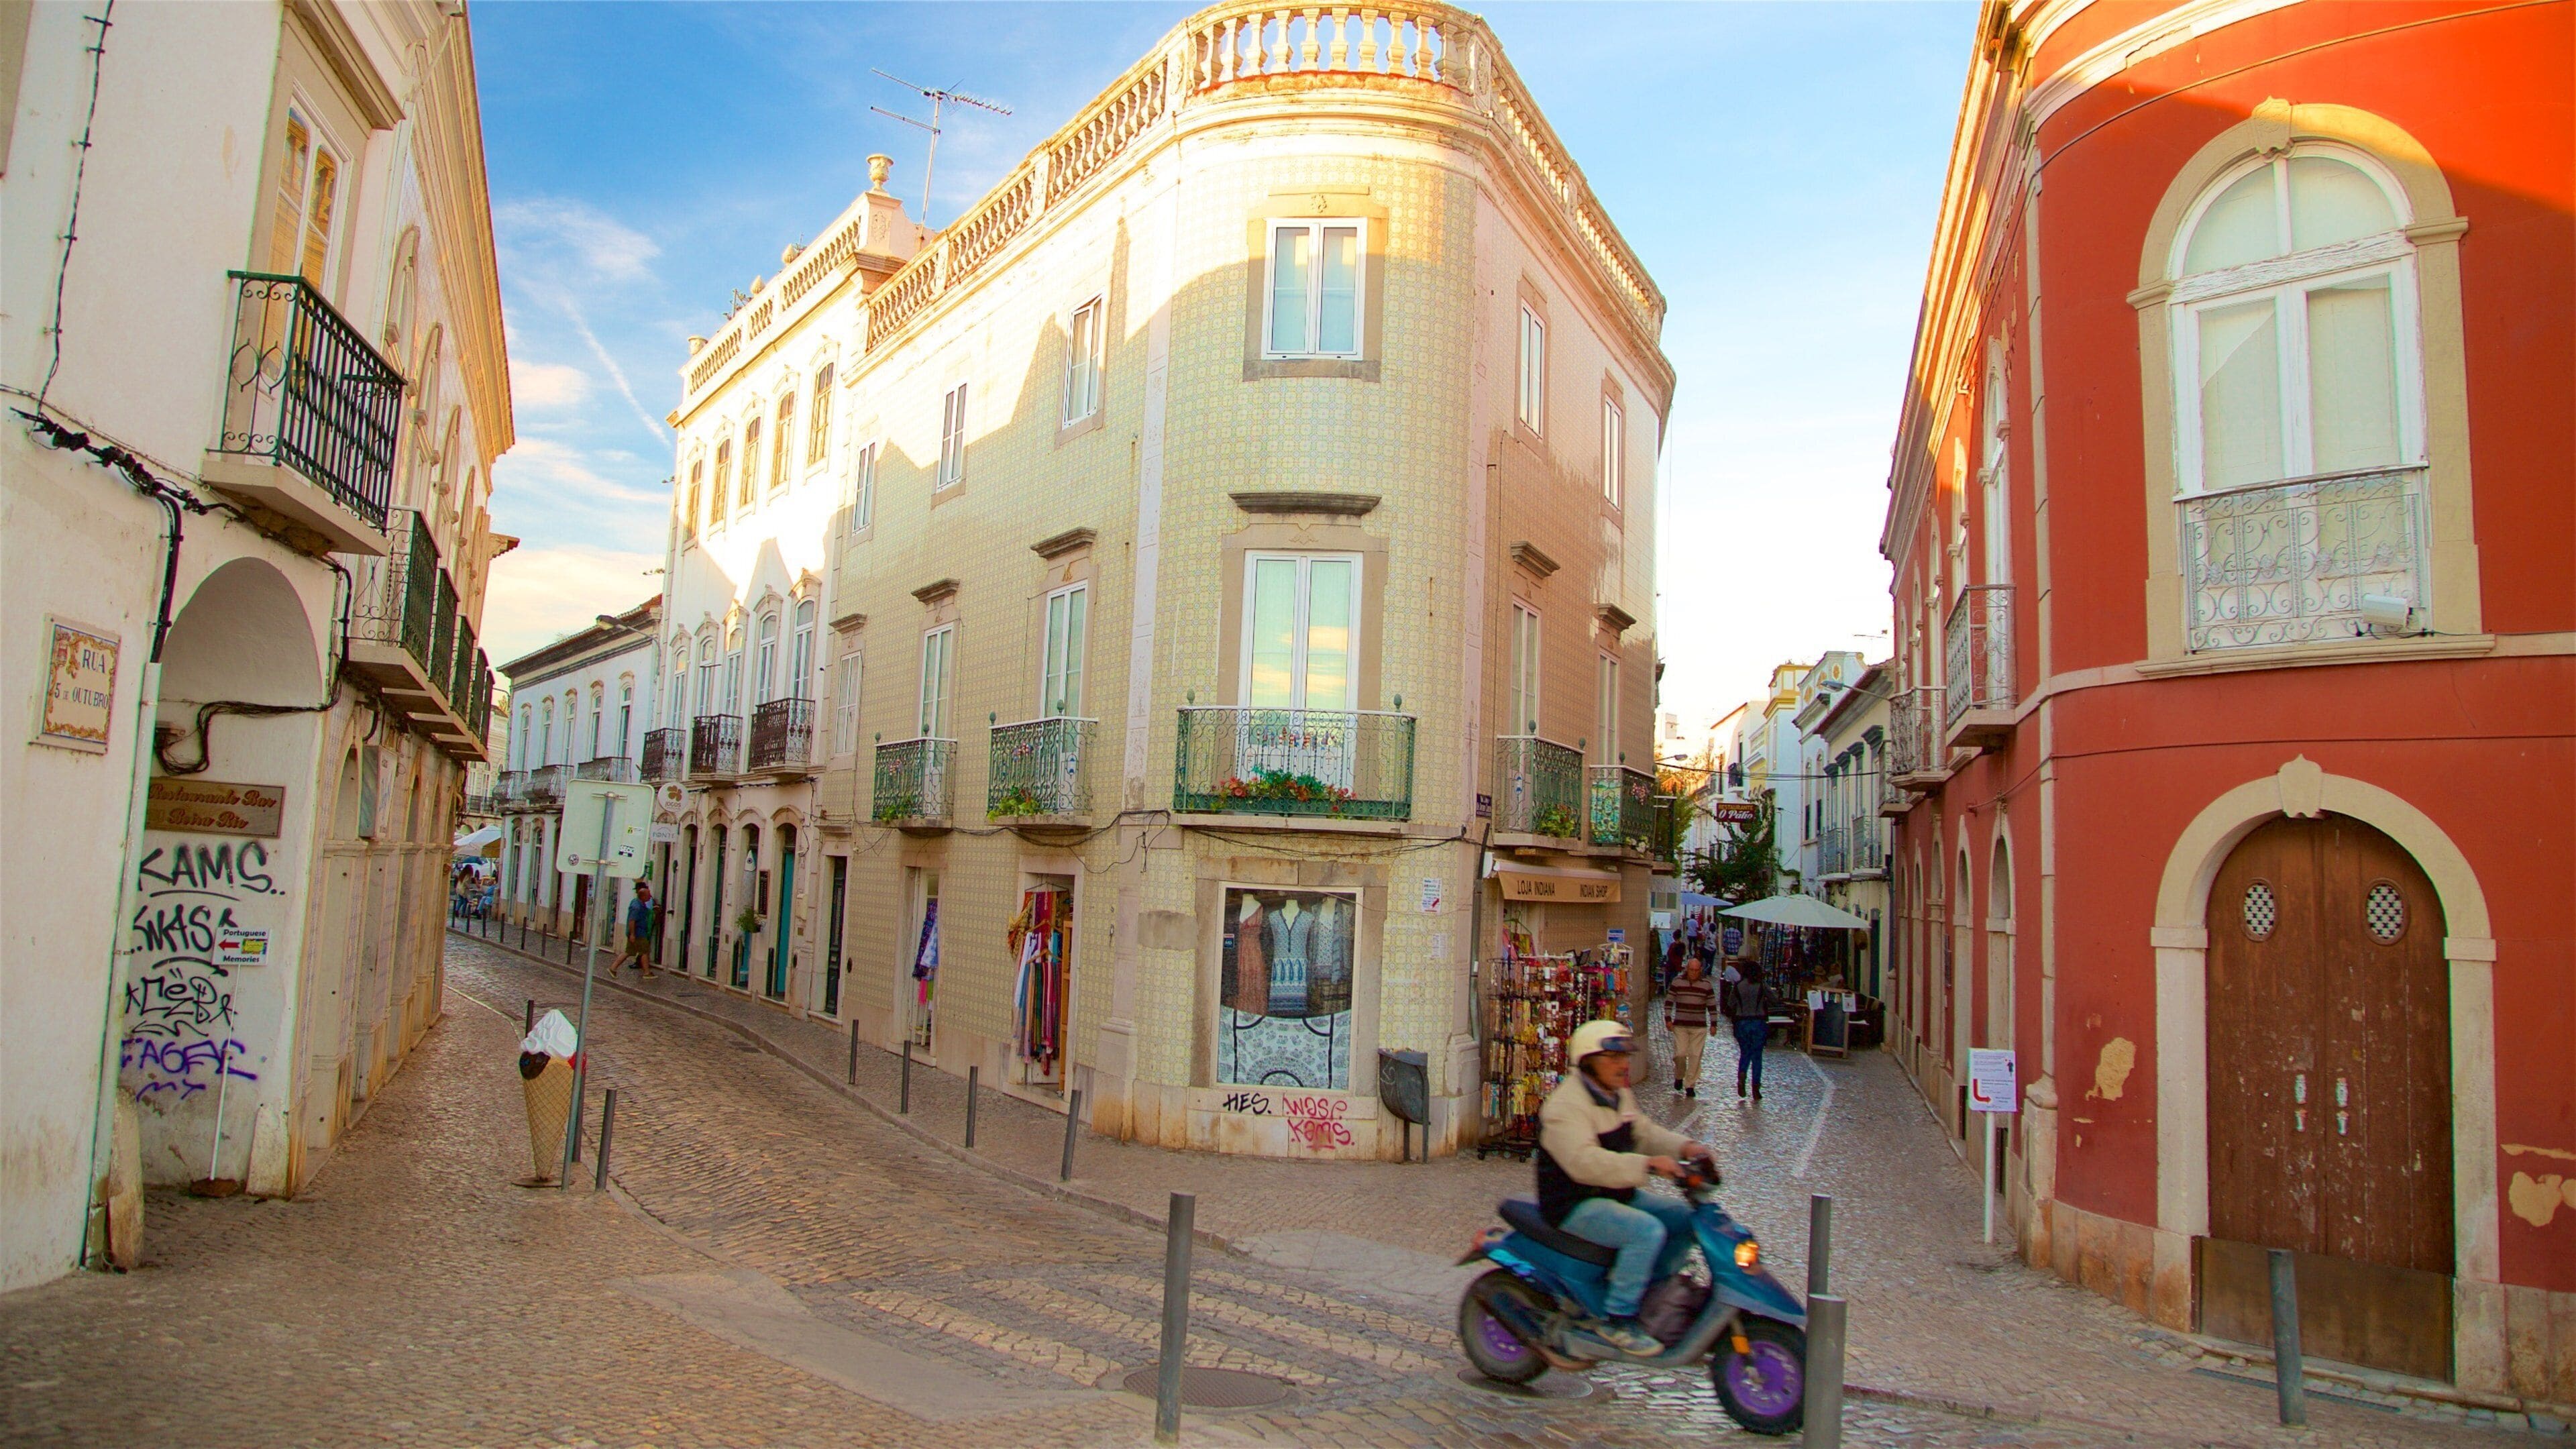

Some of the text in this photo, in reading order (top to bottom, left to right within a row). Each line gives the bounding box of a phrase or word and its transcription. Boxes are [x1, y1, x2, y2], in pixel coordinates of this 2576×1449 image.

[82, 649, 105, 674] RUA
[54, 683, 62, 698] 5
[72, 686, 109, 709] OUTUBRO
[241, 790, 277, 808] Bar
[217, 811, 249, 829] Rio
[1719, 810, 1727, 818] O
[1517, 879, 1556, 897] LOJA INDIANA
[1580, 883, 1608, 898] INDIAN SHOP
[223, 928, 266, 937] Portuguese
[223, 955, 260, 963] Memories
